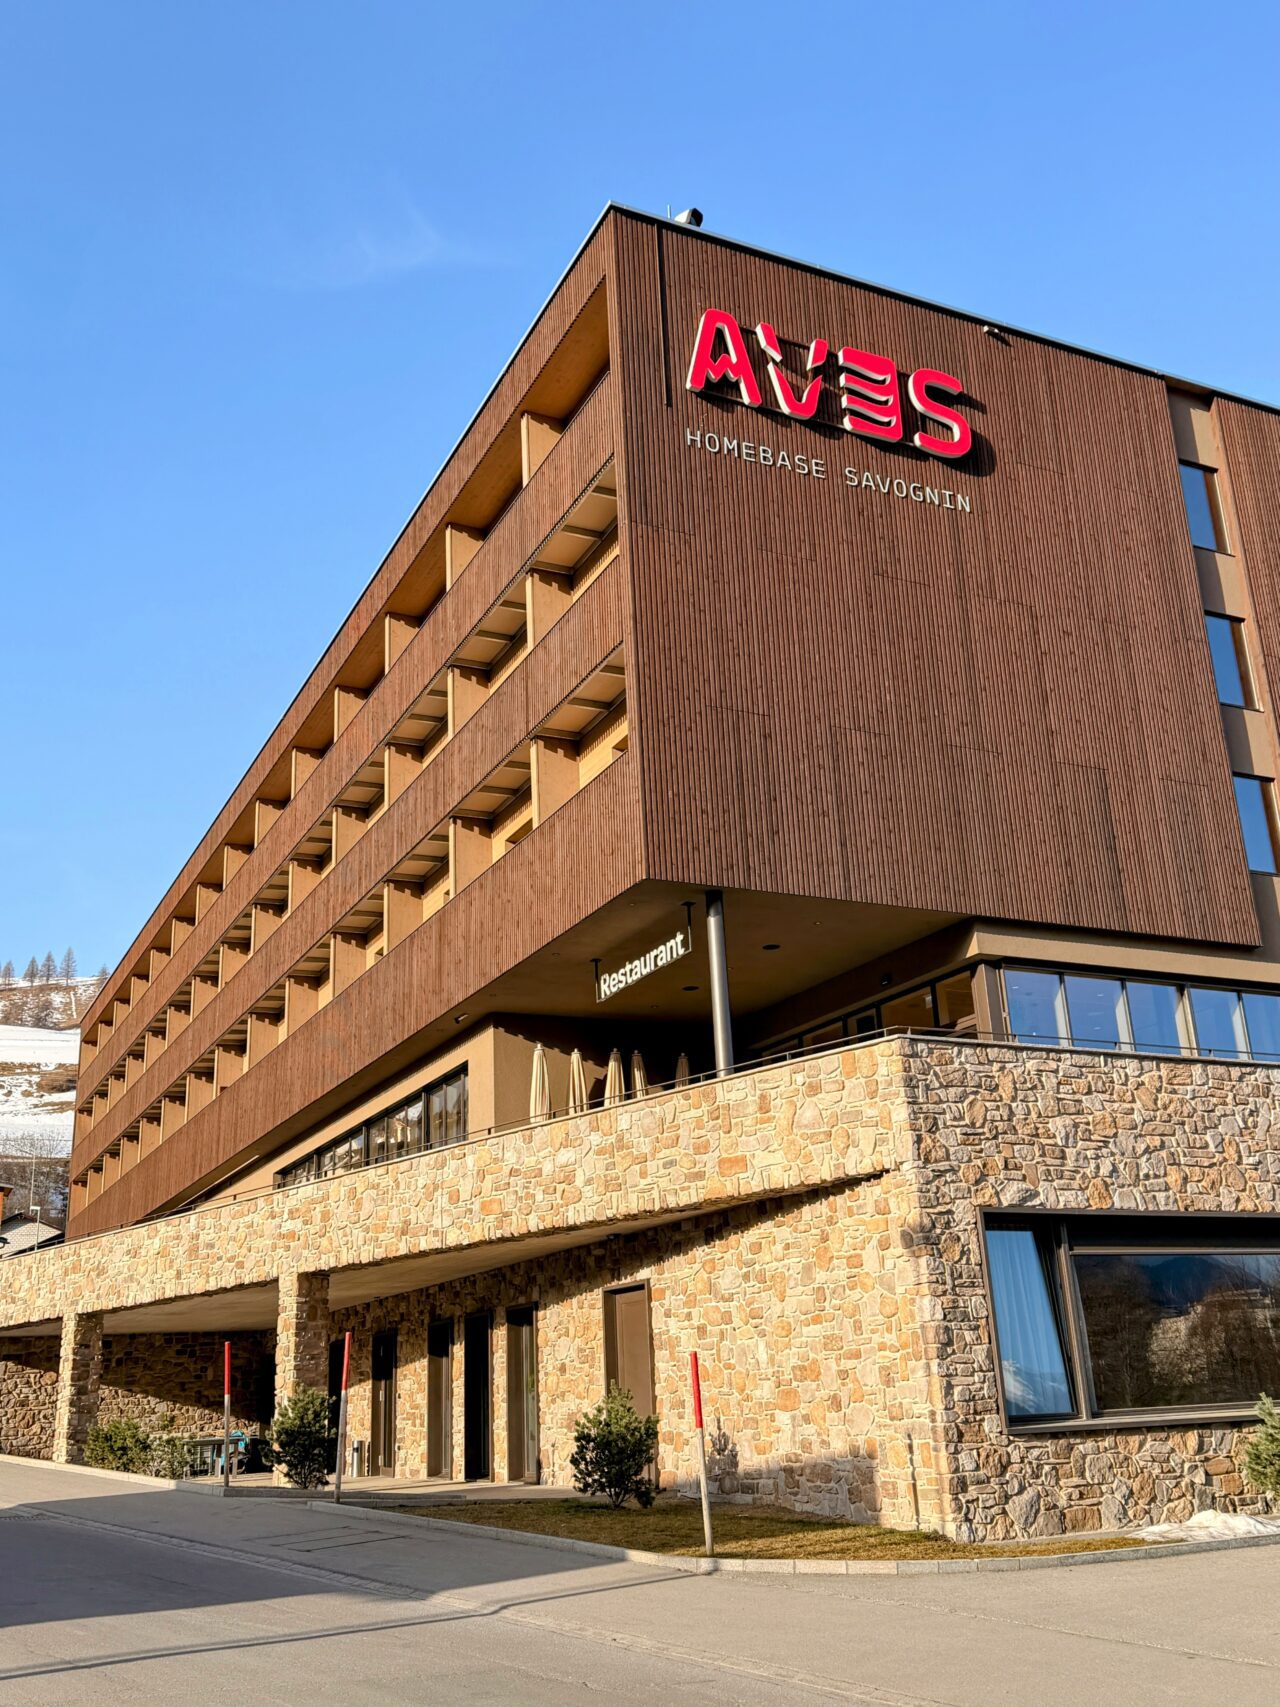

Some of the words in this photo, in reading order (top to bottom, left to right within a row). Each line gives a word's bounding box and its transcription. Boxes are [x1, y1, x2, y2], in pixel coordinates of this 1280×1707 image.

[686, 308, 972, 458] AVES
[686, 427, 826, 479] HOMEBASE
[844, 467, 971, 513] SAVOGNIN
[600, 931, 685, 999] Restaurant
